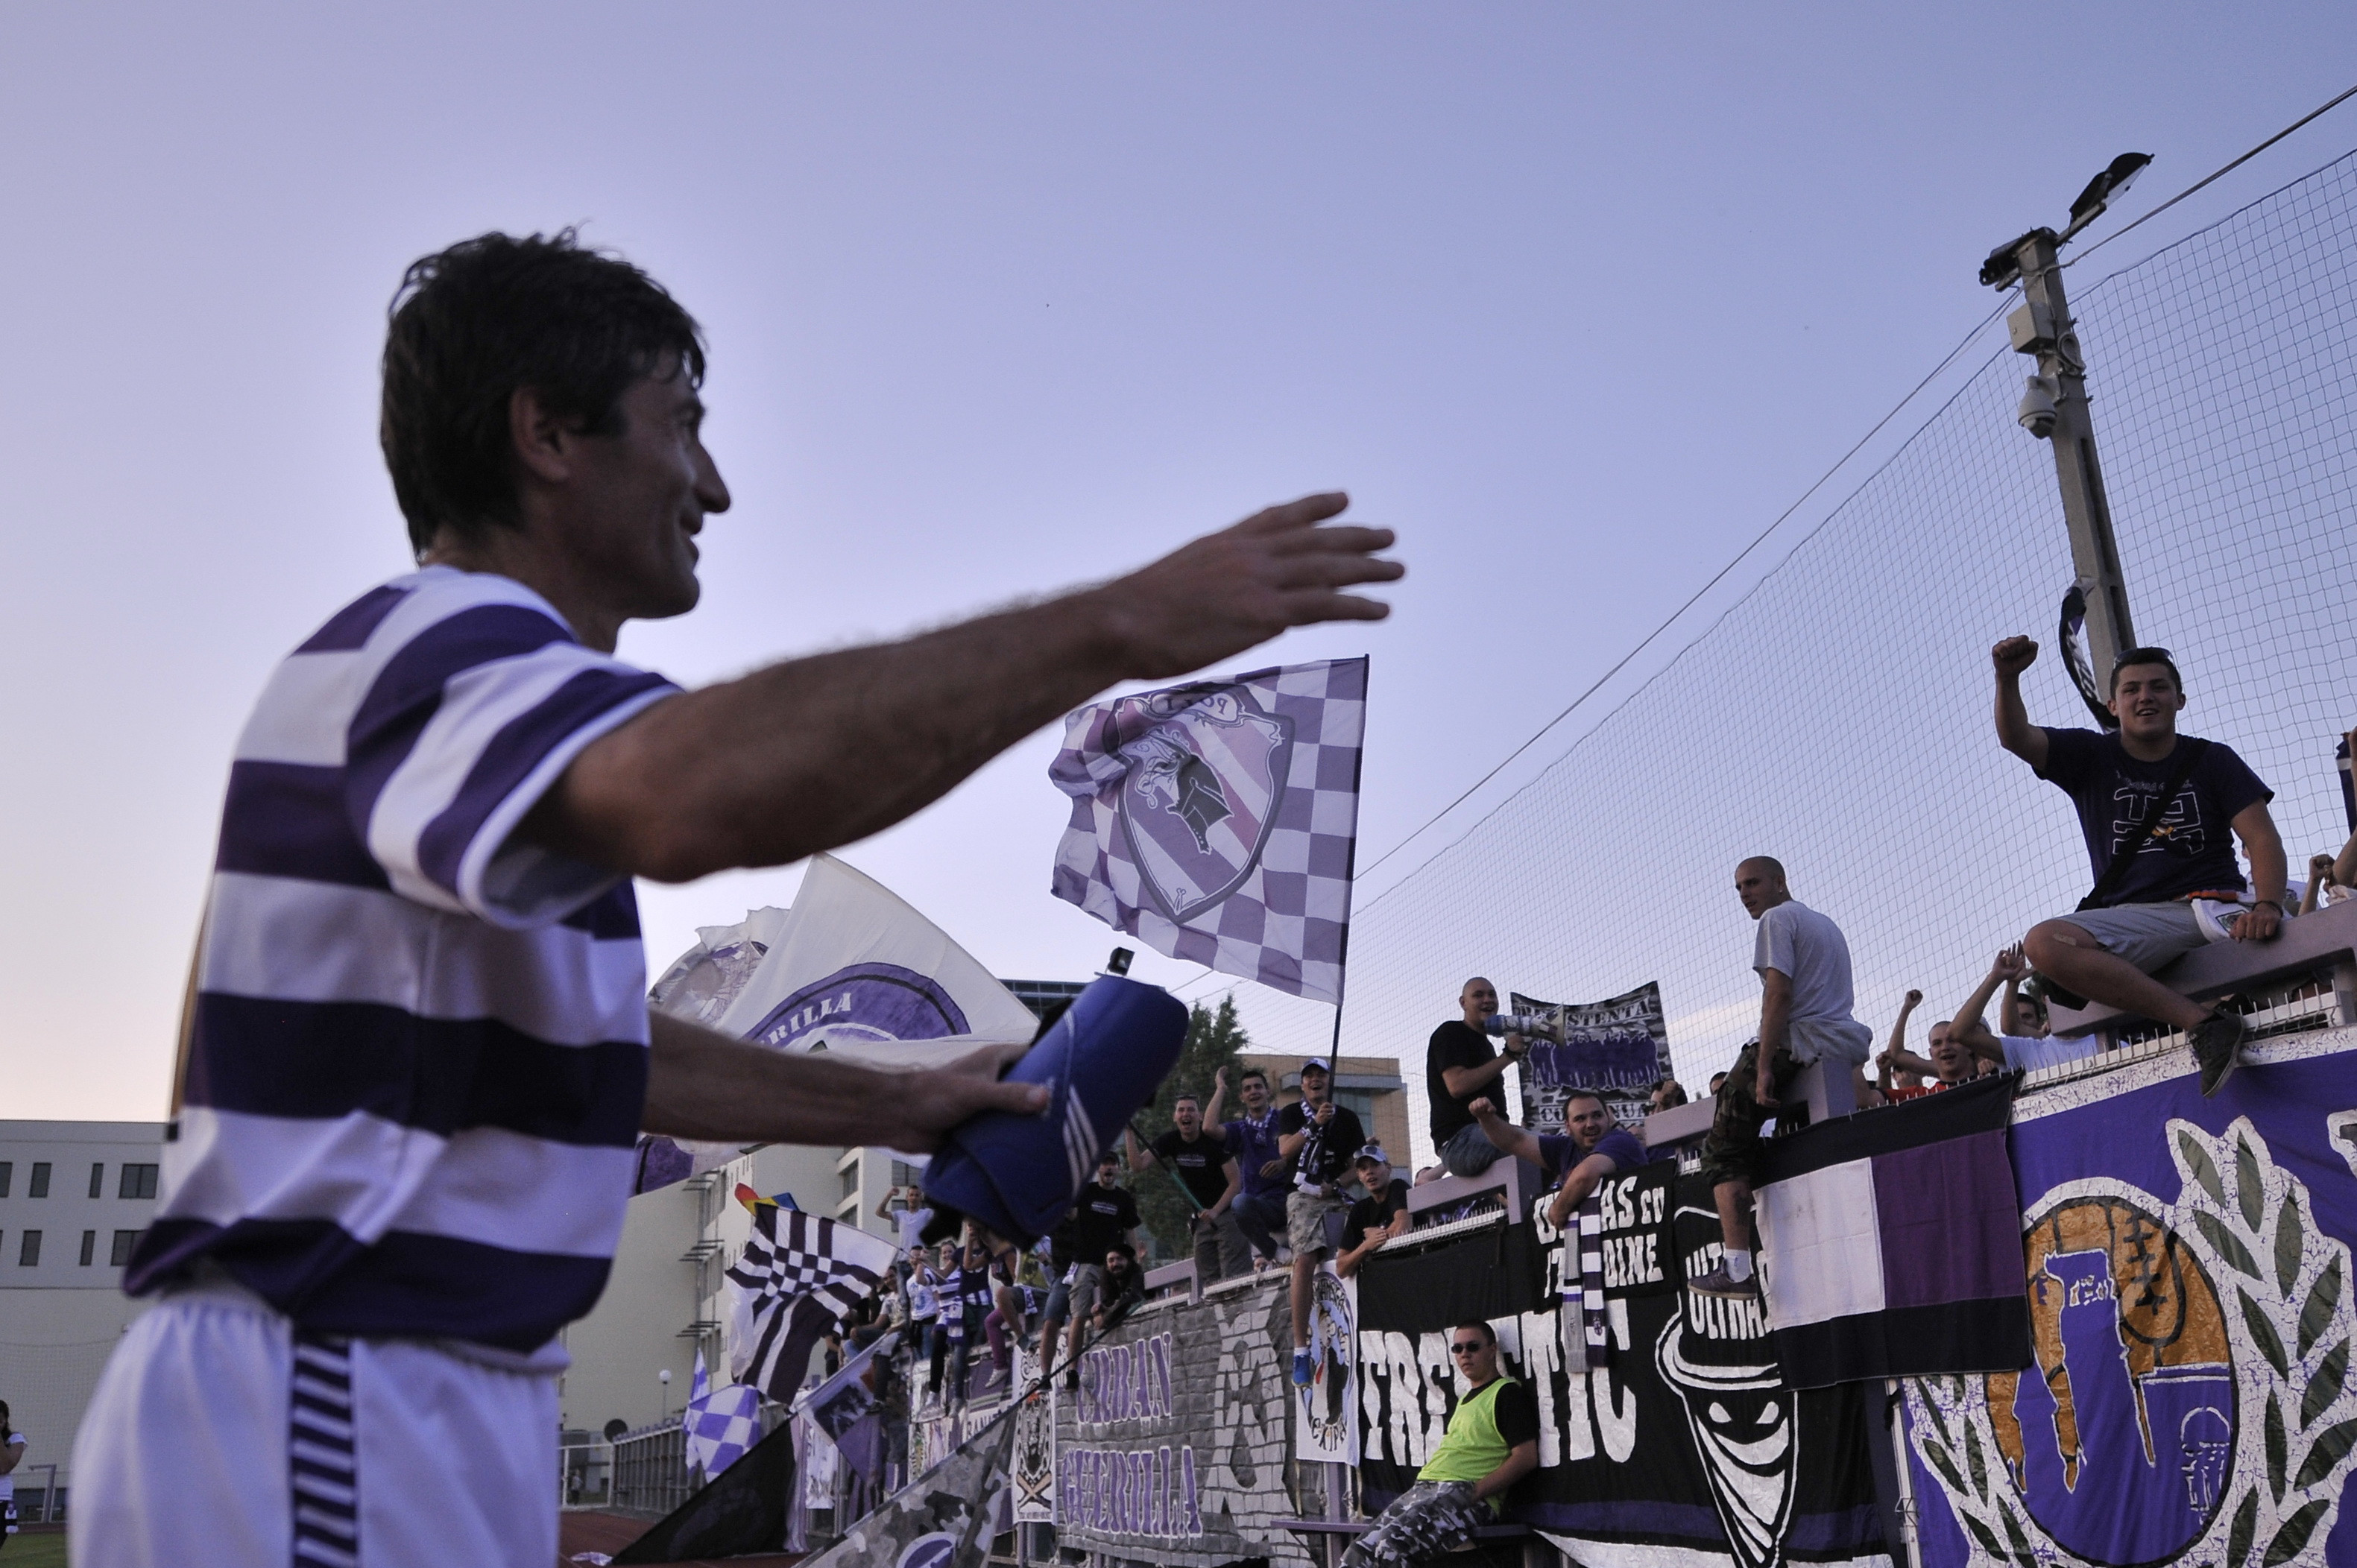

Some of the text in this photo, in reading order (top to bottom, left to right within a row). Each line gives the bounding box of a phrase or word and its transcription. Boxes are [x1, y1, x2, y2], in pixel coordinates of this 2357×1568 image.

[760, 993, 851, 1045] RILLA
[1641, 1186, 1665, 1225] CU
[1061, 1445, 1202, 1538] GUERILLA
